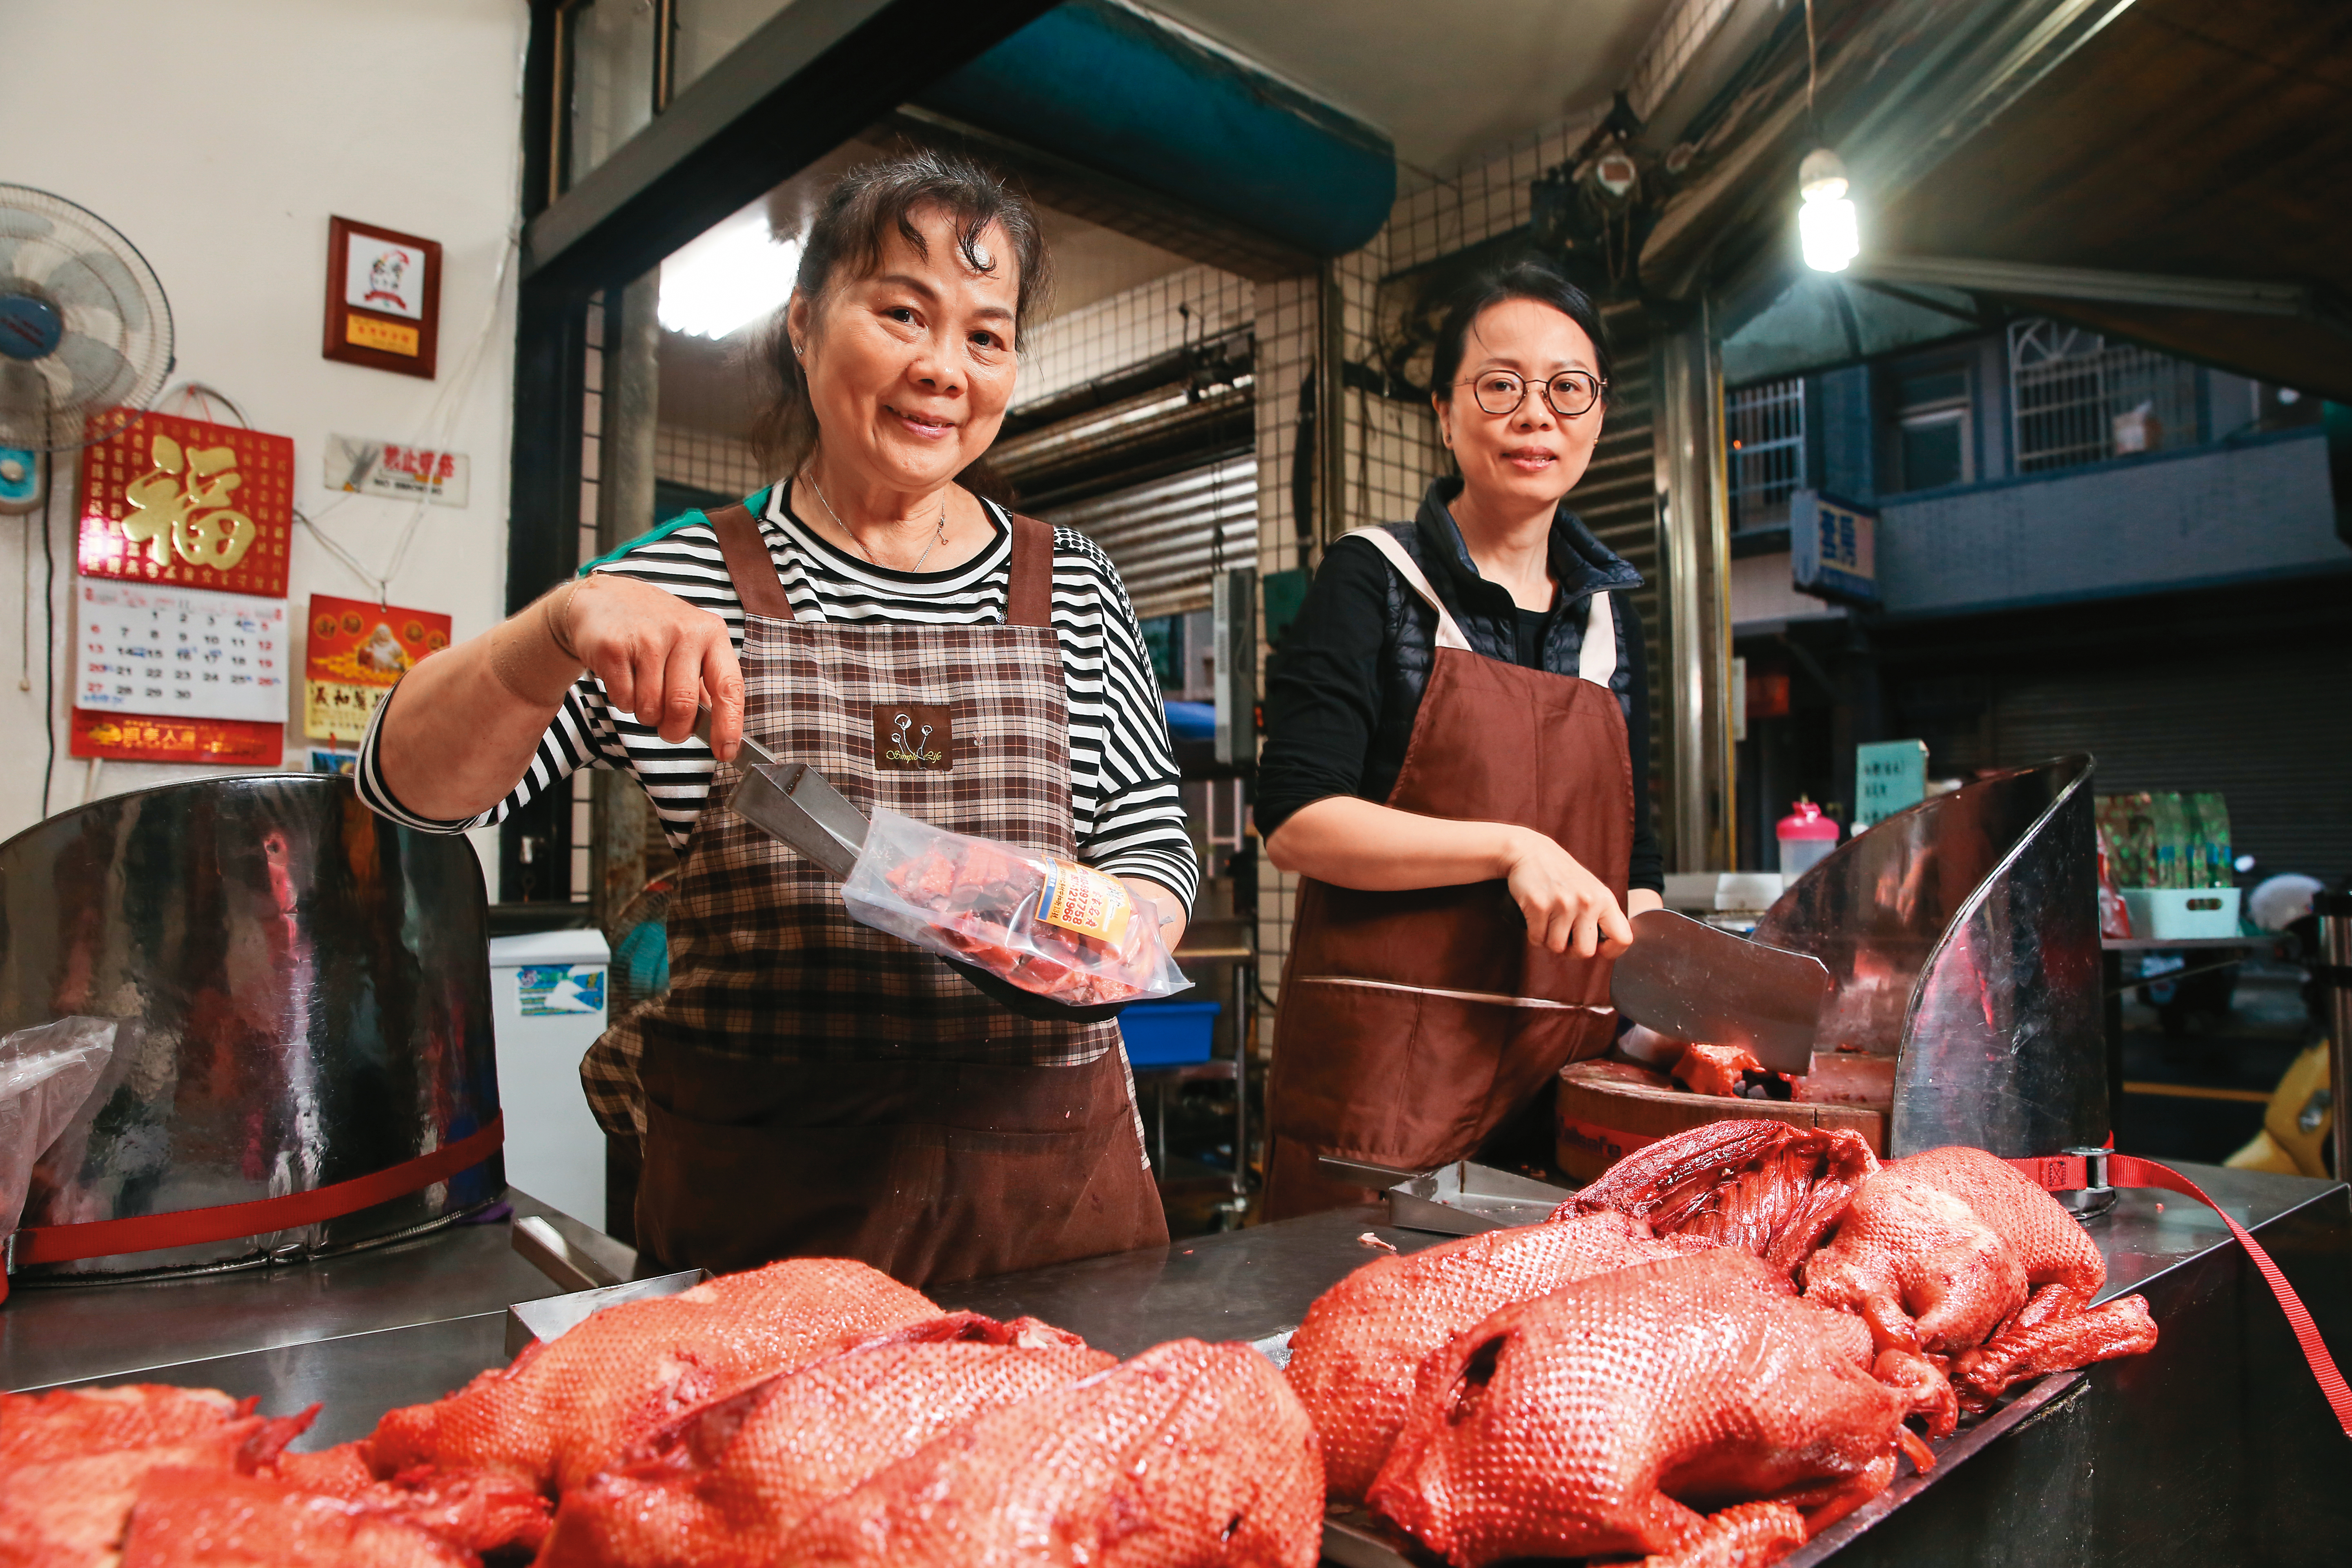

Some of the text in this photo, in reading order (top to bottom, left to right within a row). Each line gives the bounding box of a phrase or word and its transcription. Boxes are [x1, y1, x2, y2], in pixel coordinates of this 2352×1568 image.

[121, 434, 256, 571] 福
[886, 750, 942, 764] Simple Life
